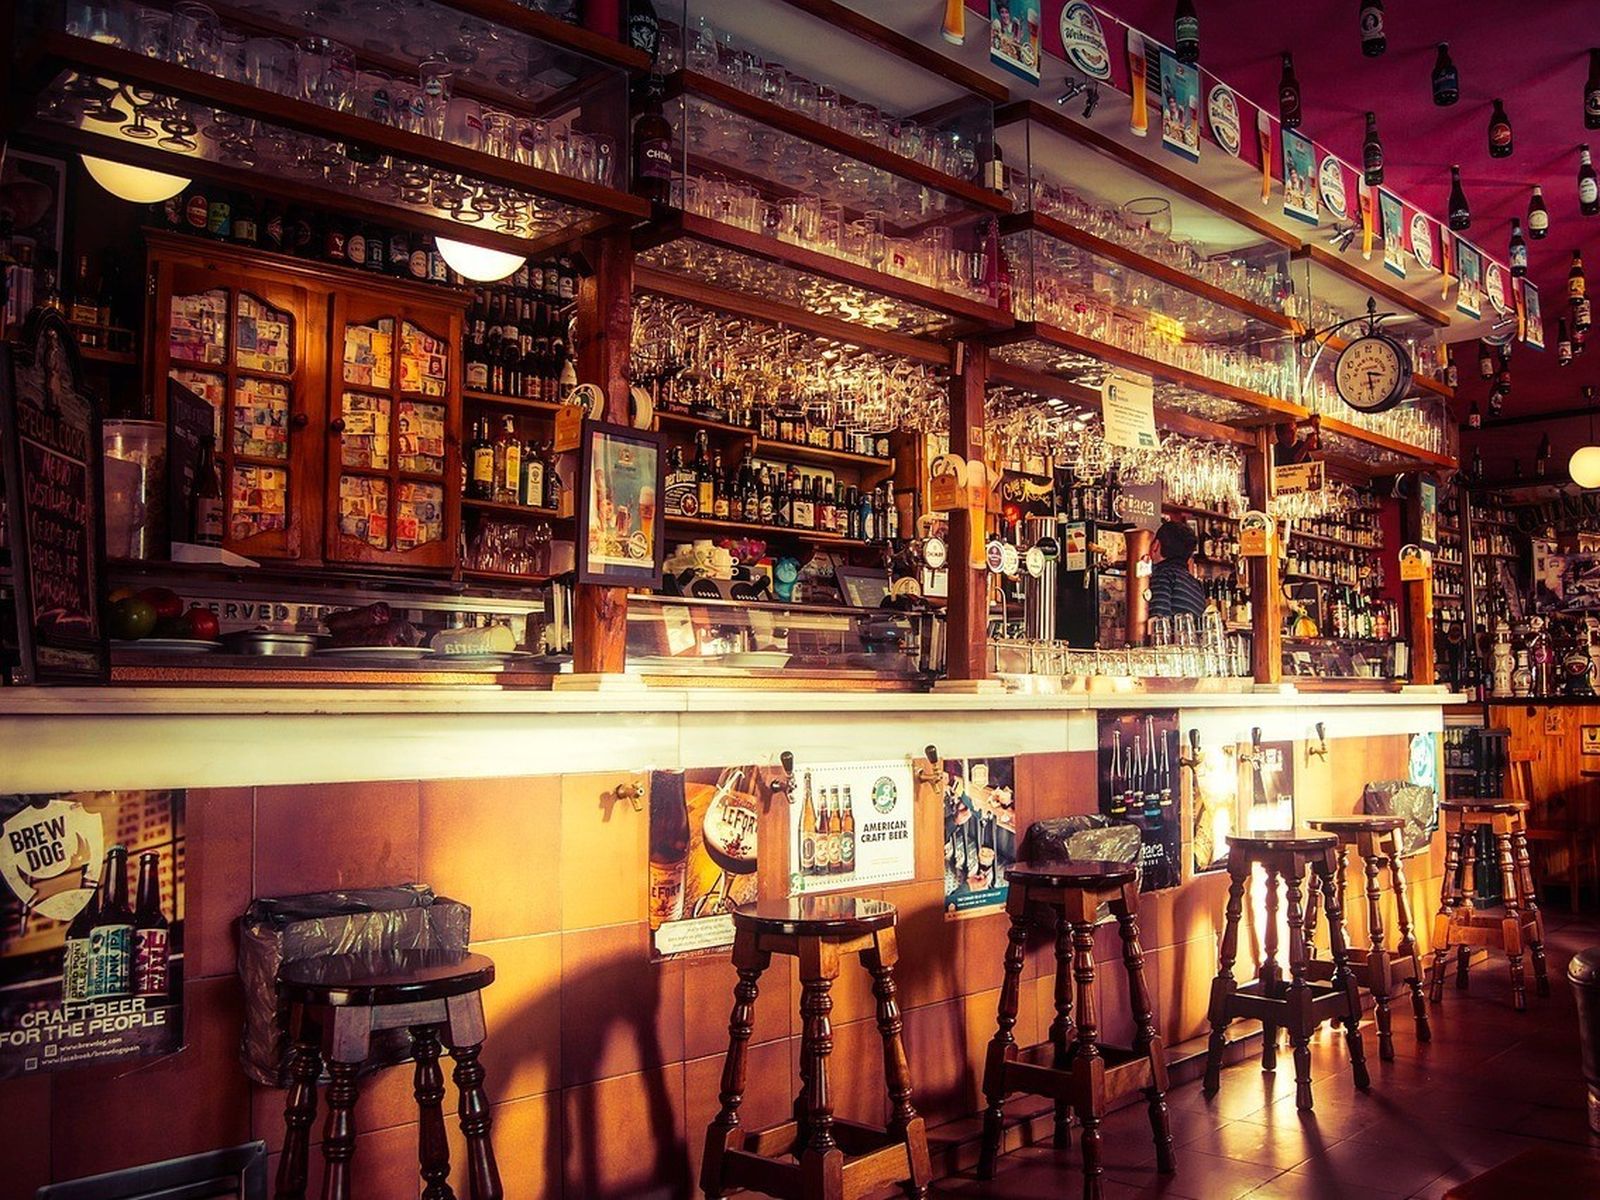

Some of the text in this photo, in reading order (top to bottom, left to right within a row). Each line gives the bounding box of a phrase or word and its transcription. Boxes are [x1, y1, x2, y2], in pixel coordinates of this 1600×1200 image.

[9, 815, 67, 854] BREW
[861, 830, 909, 843] CRAFT BEER
[863, 820, 908, 833] AMERICAN
[25, 840, 67, 873] DOG
[651, 882, 682, 899] EFORT
[108, 928, 121, 993] PUNK IPA
[20, 998, 146, 1028] CRAFT BEER
[0, 1010, 166, 1048] FOR THE PEOPLE
